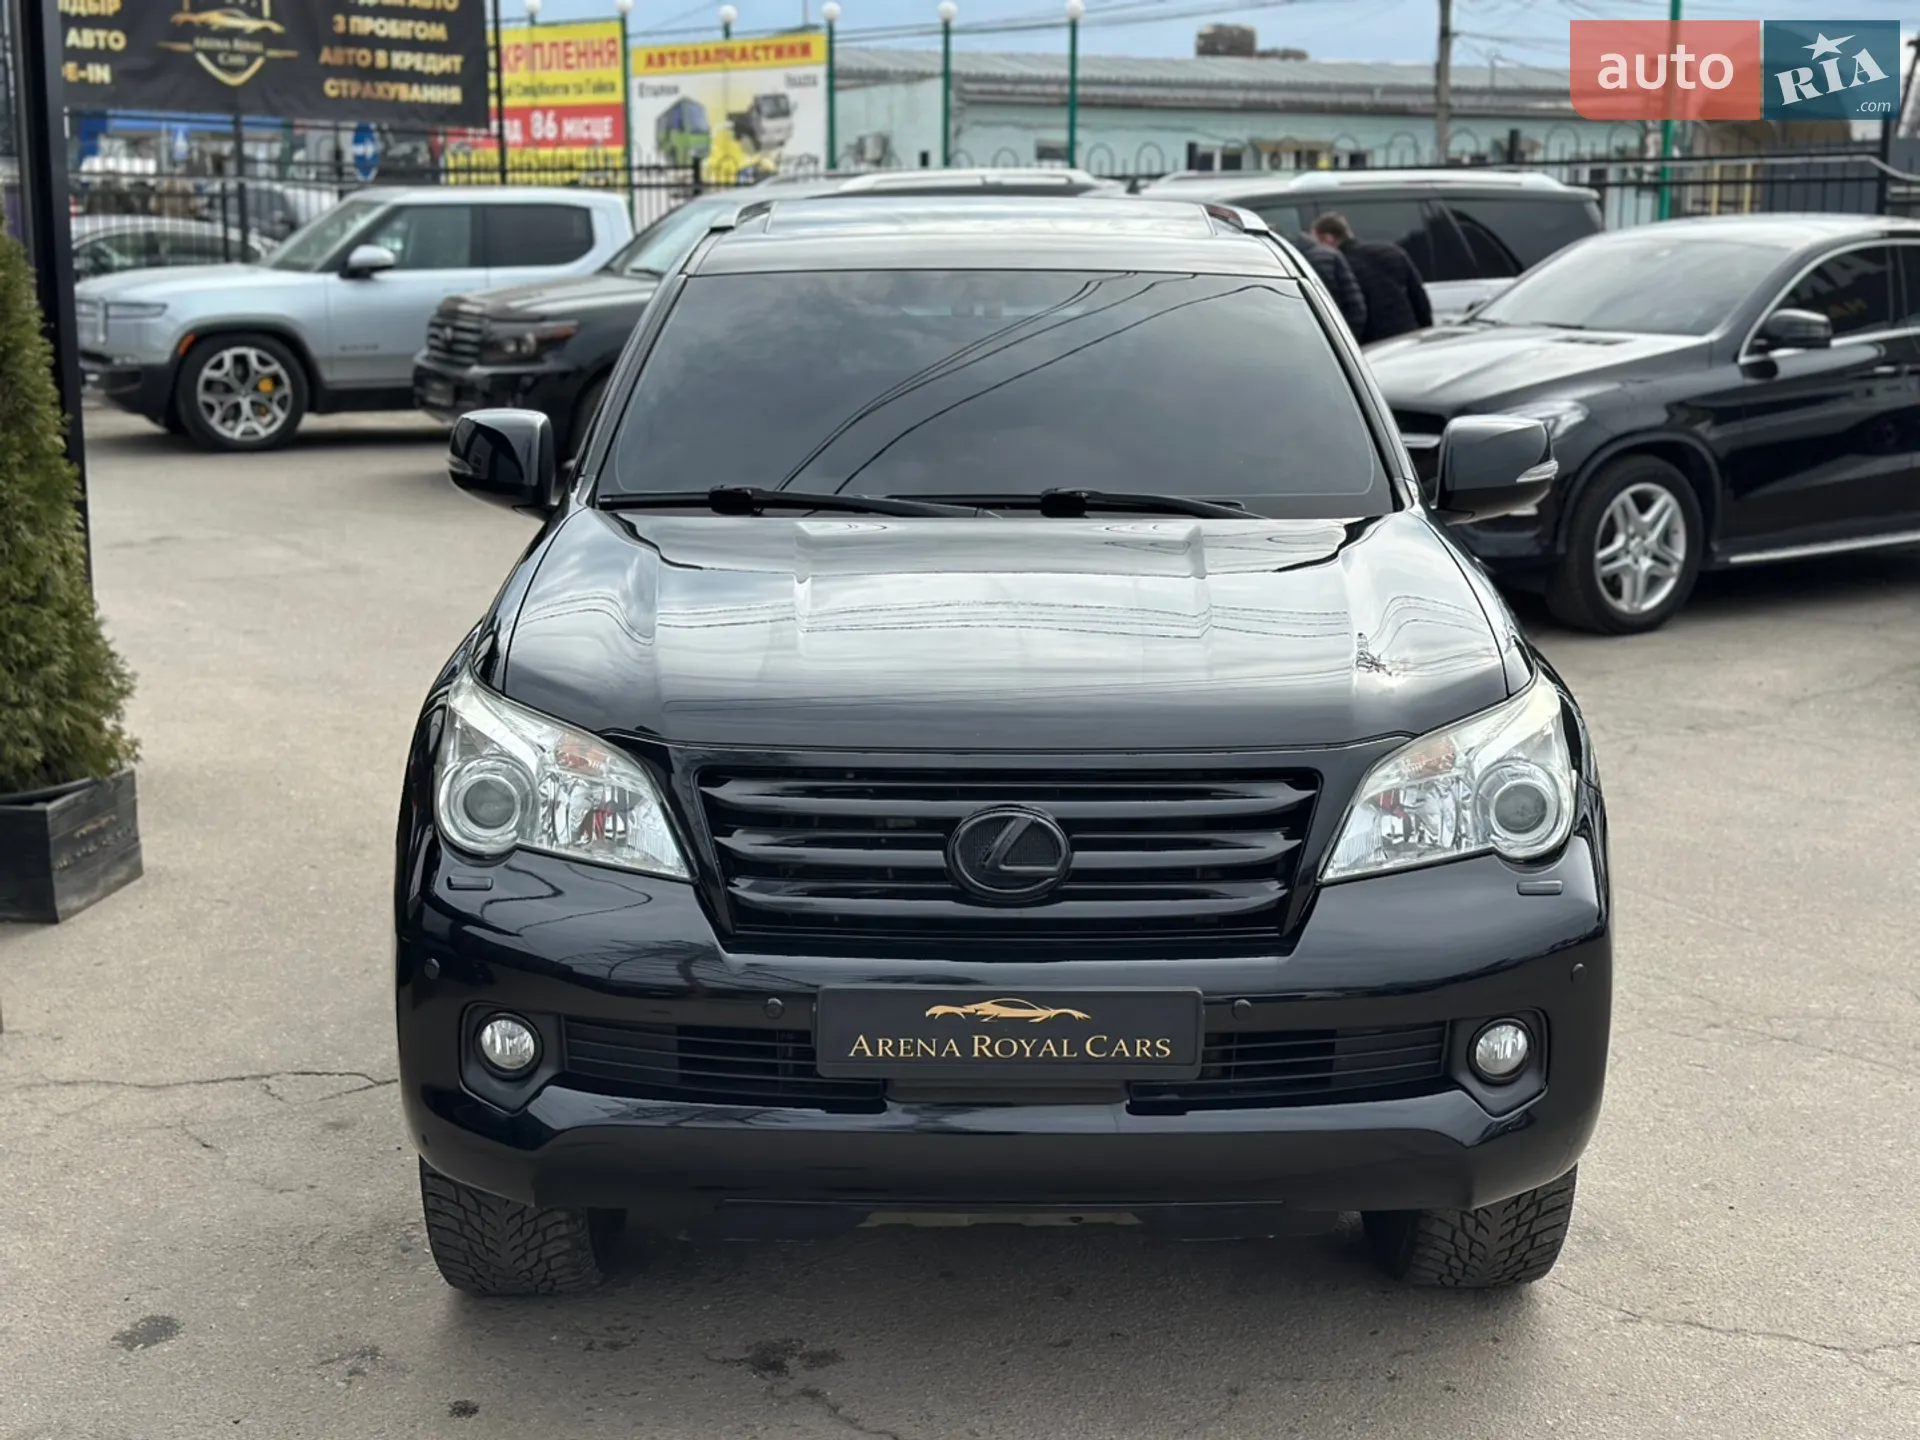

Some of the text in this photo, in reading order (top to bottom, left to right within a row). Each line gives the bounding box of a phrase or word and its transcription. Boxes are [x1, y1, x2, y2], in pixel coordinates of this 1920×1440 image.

[65, 27, 127, 51] АВТО
[349, 15, 448, 42] ПРОБІГОМ
[318, 46, 373, 68] АВТО
[390, 51, 464, 76] КРЕДИТ
[645, 40, 812, 69] АВТОЗАПЧАСТИНИ
[323, 77, 463, 105] СТРАХУВАННЯ
[531, 110, 557, 140] 86
[848, 1034, 1172, 1058] ARENA ROYAL CARS
